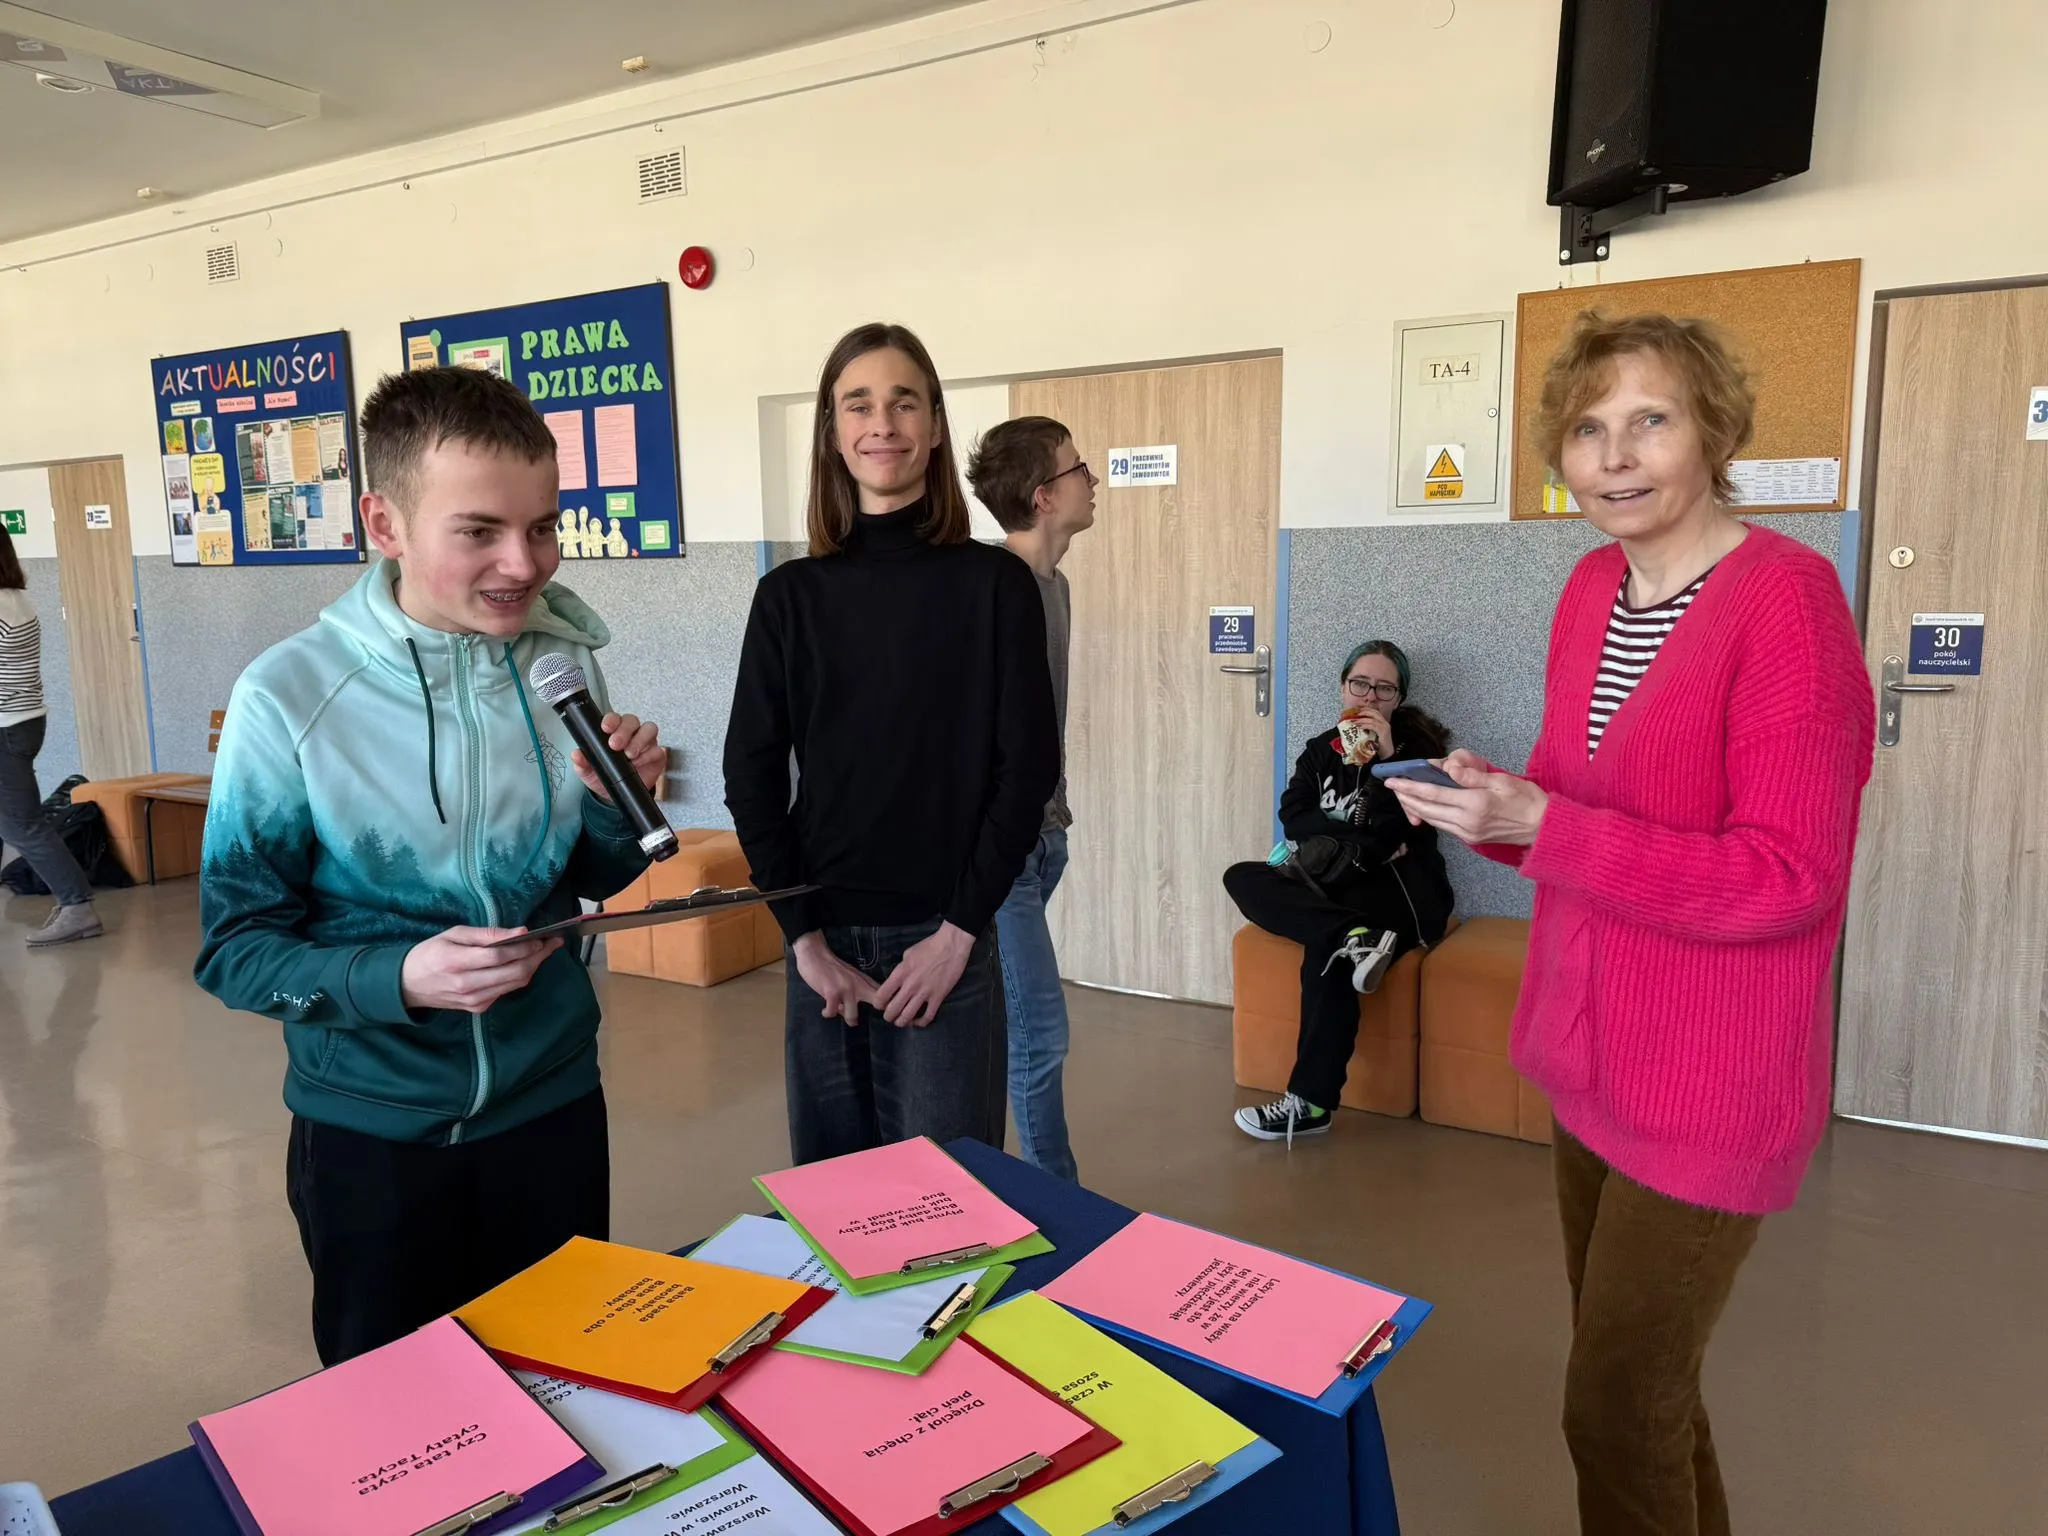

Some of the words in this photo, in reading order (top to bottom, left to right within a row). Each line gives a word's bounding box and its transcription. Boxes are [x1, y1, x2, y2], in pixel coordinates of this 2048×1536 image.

[521, 319, 629, 360] PRAWA
[160, 343, 335, 396] AKTUALNOŚCI
[1430, 361, 1470, 378] TA-4
[528, 362, 663, 401] DZIECKA
[1132, 454, 1163, 462] PRACOWNIA
[1132, 462, 1170, 470] PRZEDMIOTÓW
[1112, 458, 1128, 475] 29
[1132, 470, 1169, 478] ZAWODOWYCH
[1224, 617, 1239, 632] 29
[1934, 627, 1960, 647] 30
[1934, 650, 1956, 658] pokój
[918, 1191, 946, 1202] Bug.
[929, 1197, 952, 1206] buk
[868, 1209, 905, 1222] wpadł
[899, 1210, 931, 1220] dałby
[927, 1209, 964, 1220] Płynie
[934, 1203, 958, 1212] Bug
[838, 1224, 868, 1234] żeby
[863, 1224, 897, 1235] przez
[871, 1218, 896, 1227] Bóg
[901, 1218, 924, 1227] buk
[1217, 1262, 1240, 1279] jeży
[1234, 1268, 1252, 1280] tej
[636, 1280, 665, 1298] Baba
[1214, 1278, 1240, 1298] wieży
[1245, 1276, 1260, 1288] nie
[1258, 1278, 1280, 1294] Leży
[603, 1277, 653, 1307] baobaby.
[633, 1283, 682, 1314] baobaby.
[666, 1286, 695, 1304] Baba
[1218, 1288, 1248, 1312] wierzy,
[615, 1298, 637, 1312] dba
[1200, 1296, 1220, 1312] jest
[1238, 1293, 1264, 1312] Jerzy
[639, 1304, 669, 1322] bada
[1186, 1311, 1202, 1323] sto
[1208, 1312, 1224, 1322] że
[1228, 1312, 1242, 1322] na
[583, 1319, 606, 1333] oba
[1201, 1322, 1211, 1330] w
[1204, 1322, 1231, 1343] wieży
[1062, 1371, 1099, 1392] szosa
[1097, 1380, 1113, 1390] W
[544, 1390, 572, 1405] cóż
[941, 1390, 972, 1409] pień
[908, 1407, 939, 1423] ciął.
[928, 1399, 985, 1430] Dzięcioł
[426, 1424, 479, 1453] cytaty
[457, 1432, 486, 1450] Czy
[863, 1433, 914, 1458] chęcią
[414, 1450, 451, 1470] tata
[352, 1454, 421, 1484] Tacyta.
[359, 1470, 408, 1495] czyta
[666, 1483, 748, 1520] Warszawie.
[695, 1494, 758, 1524] wrzawie,
[681, 1524, 695, 1533] w
[699, 1506, 771, 1536] Warszaw
